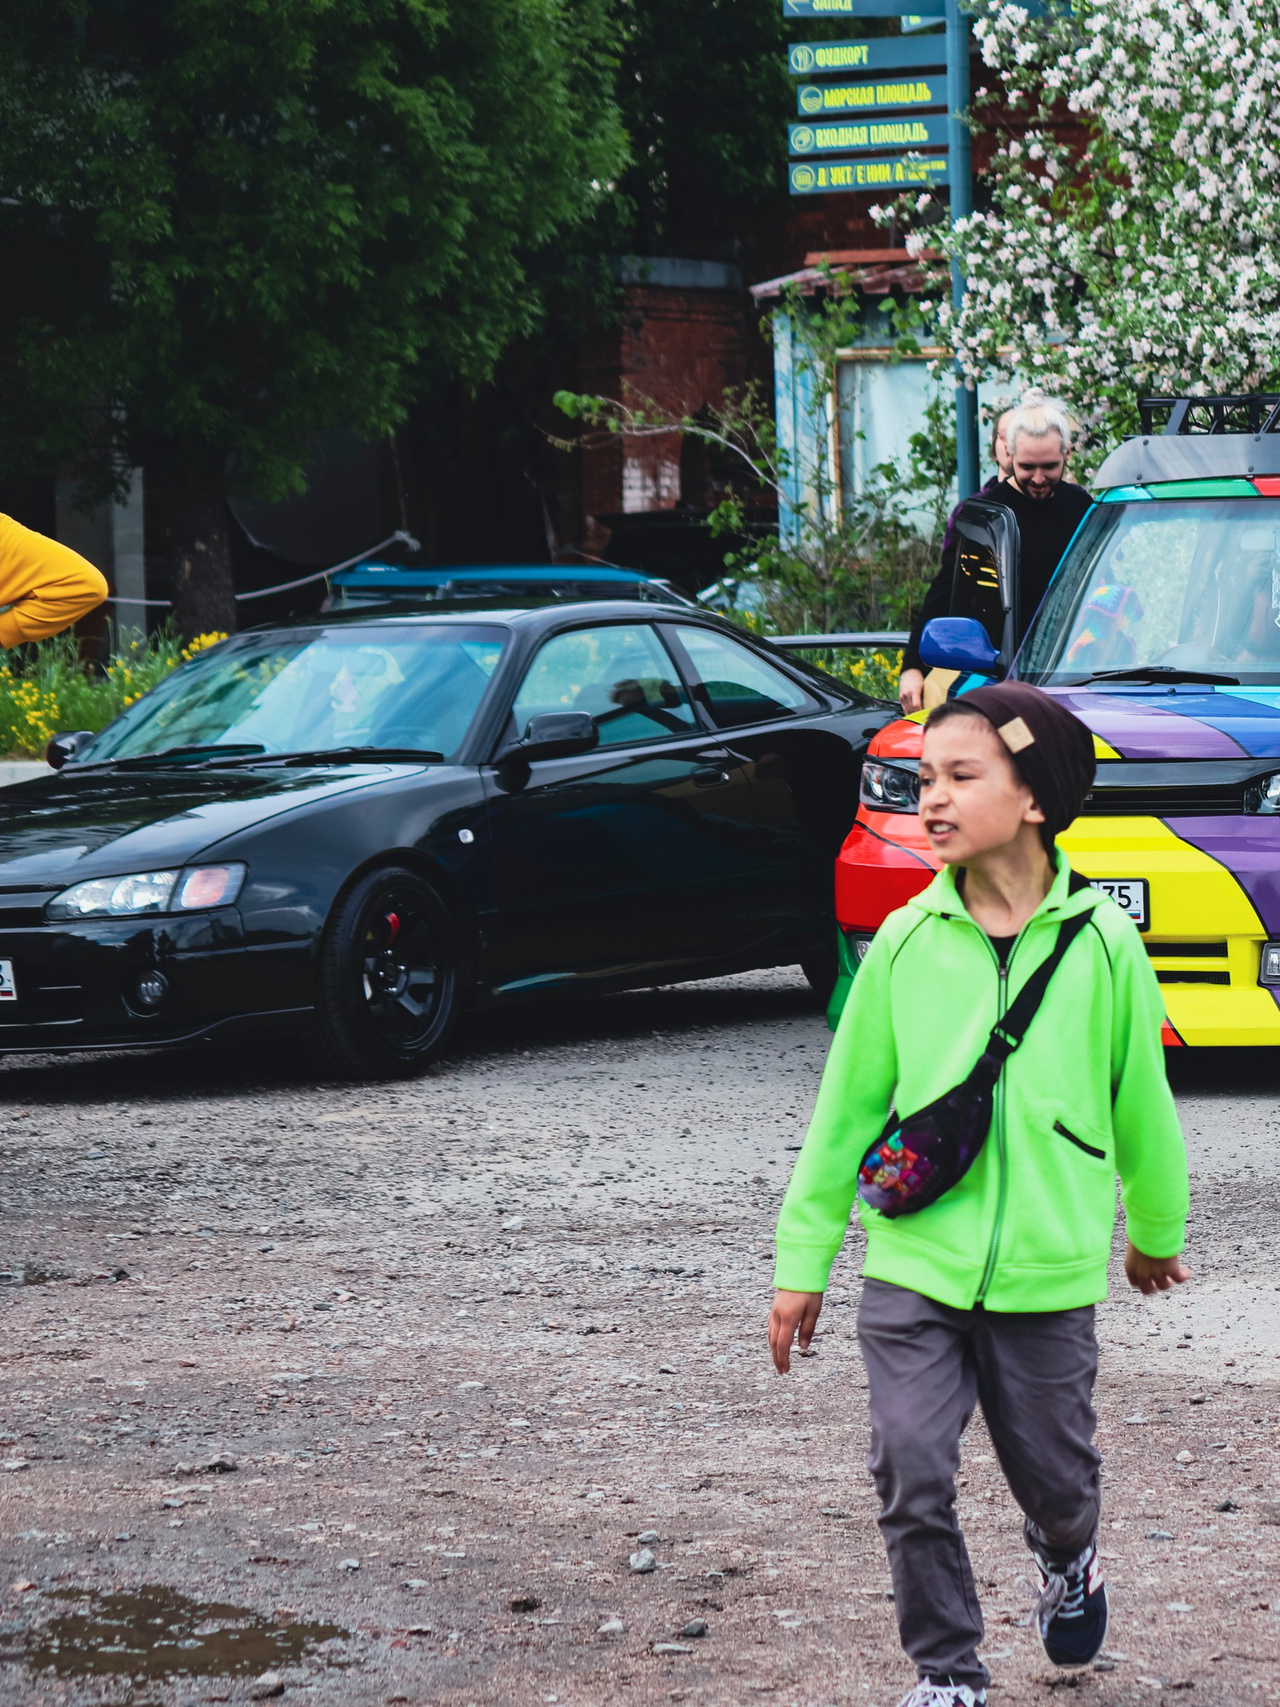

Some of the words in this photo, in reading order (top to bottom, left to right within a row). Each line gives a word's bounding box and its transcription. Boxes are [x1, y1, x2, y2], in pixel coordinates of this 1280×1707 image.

[815, 45, 868, 67] ФУДКОРТ
[823, 86, 875, 108] МОРСКАЯ
[876, 82, 932, 105] ПЛОЩАДЬ
[815, 126, 868, 148] ВХОДНАЯ
[869, 122, 929, 145] ПЛОЩАДЬ
